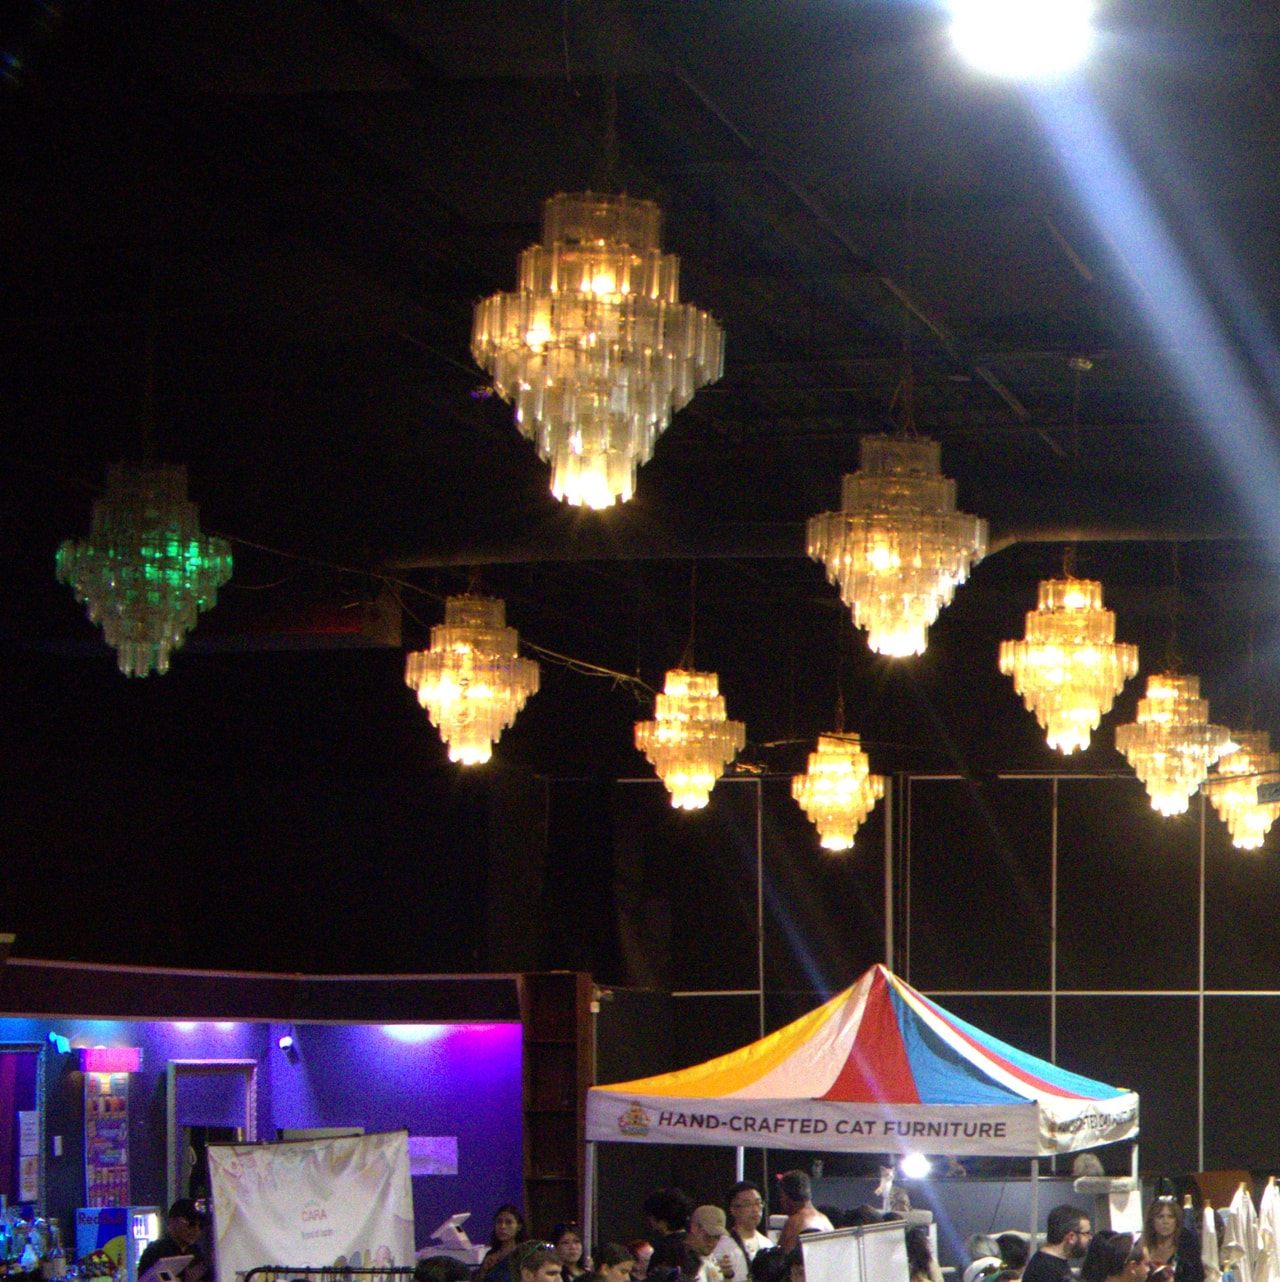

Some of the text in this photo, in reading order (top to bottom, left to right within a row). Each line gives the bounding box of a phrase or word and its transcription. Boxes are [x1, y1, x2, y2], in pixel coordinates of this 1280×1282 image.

[658, 1111, 1007, 1138] HAND-CRAFTED CAT FURNITURE
[78, 1212, 99, 1225] Red
